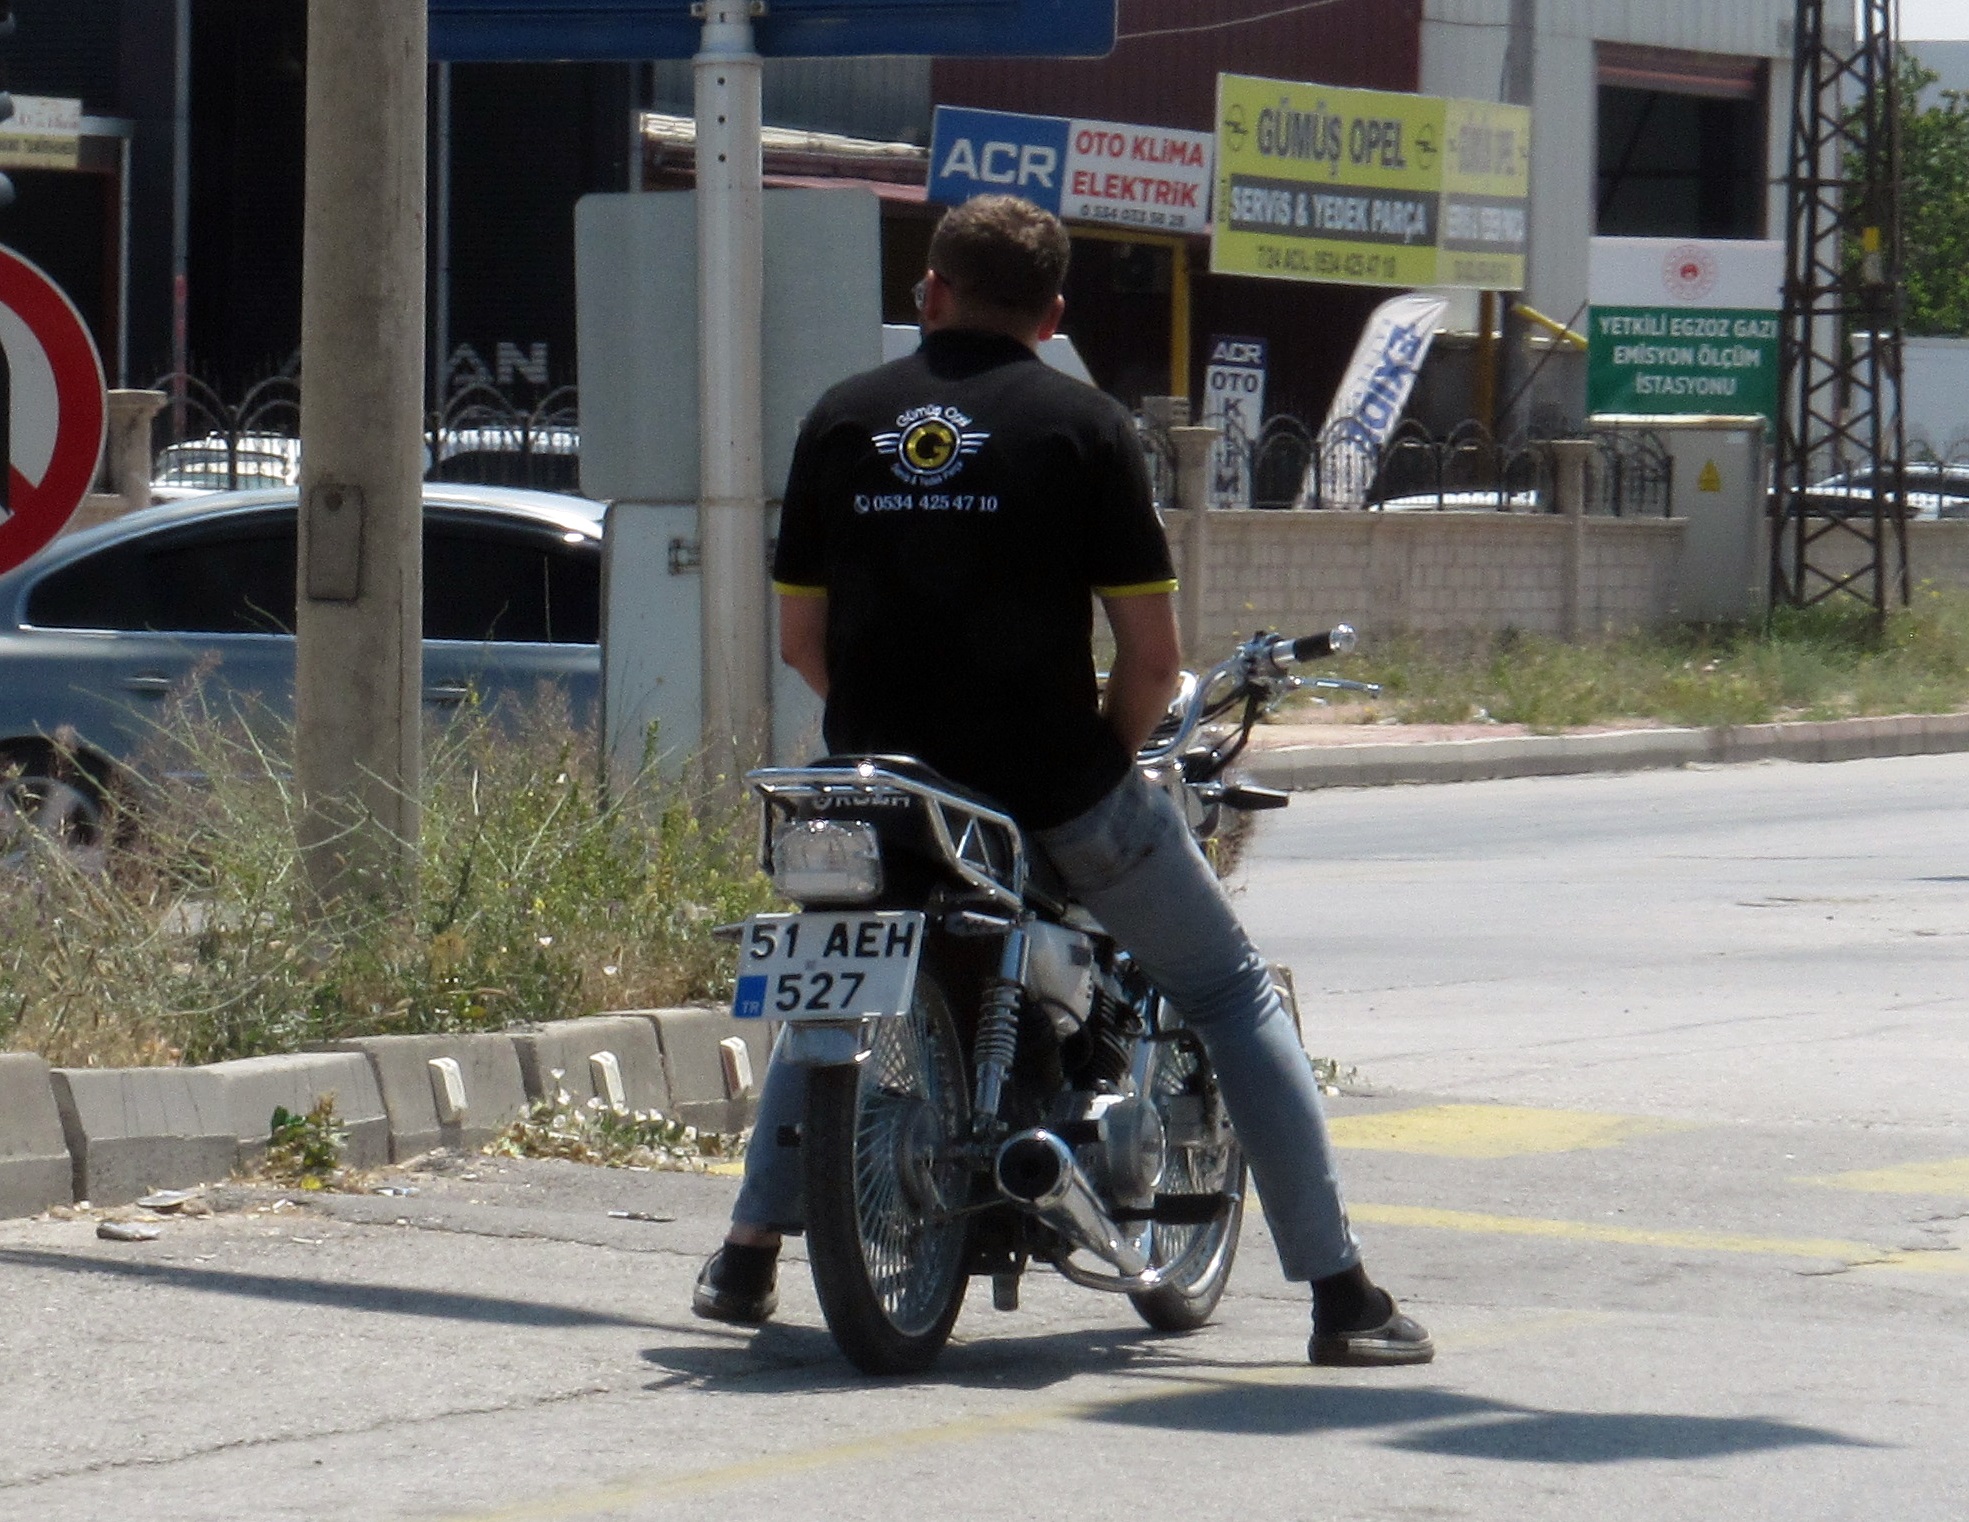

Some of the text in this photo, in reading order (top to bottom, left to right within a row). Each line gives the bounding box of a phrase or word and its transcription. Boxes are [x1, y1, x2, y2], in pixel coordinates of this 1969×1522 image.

[1075, 130, 1125, 158] OTO
[1349, 116, 1407, 169] OPEL
[939, 138, 1057, 188] ACR
[1670, 317, 1729, 337] EGZOZ
[1211, 341, 1262, 365] ACR
[1212, 371, 1258, 393] OTO
[873, 494, 998, 512] 0534 425 47 10
[751, 921, 916, 960] 51 AEH
[776, 971, 866, 1012] 527
